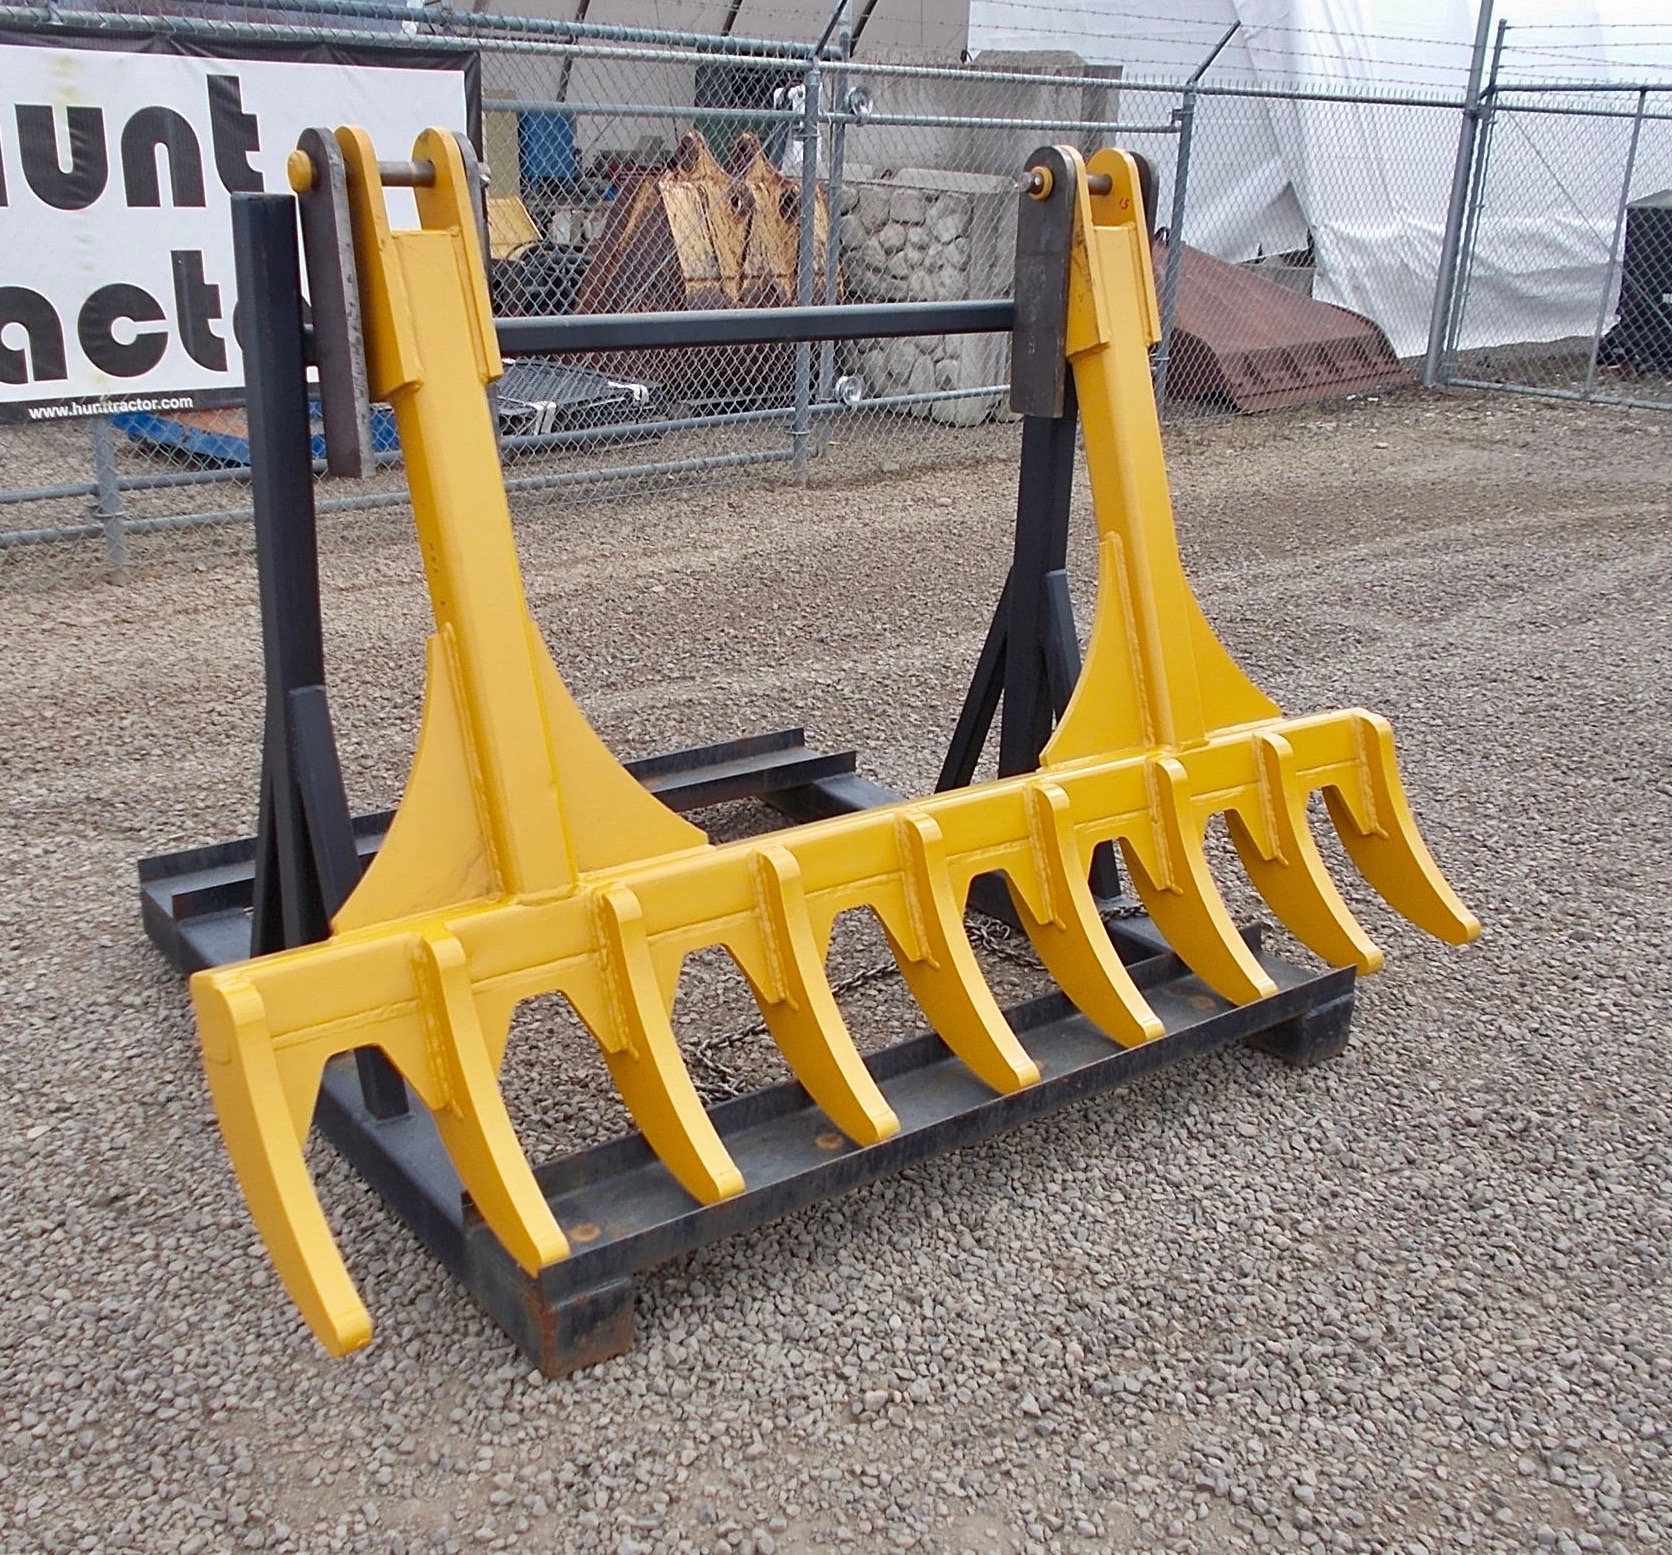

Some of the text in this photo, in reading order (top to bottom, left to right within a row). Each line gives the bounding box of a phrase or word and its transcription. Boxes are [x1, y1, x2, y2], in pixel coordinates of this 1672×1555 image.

[0, 74, 264, 210] unt
[0, 250, 243, 384] act
[28, 396, 193, 419] www.hunttractor.com
